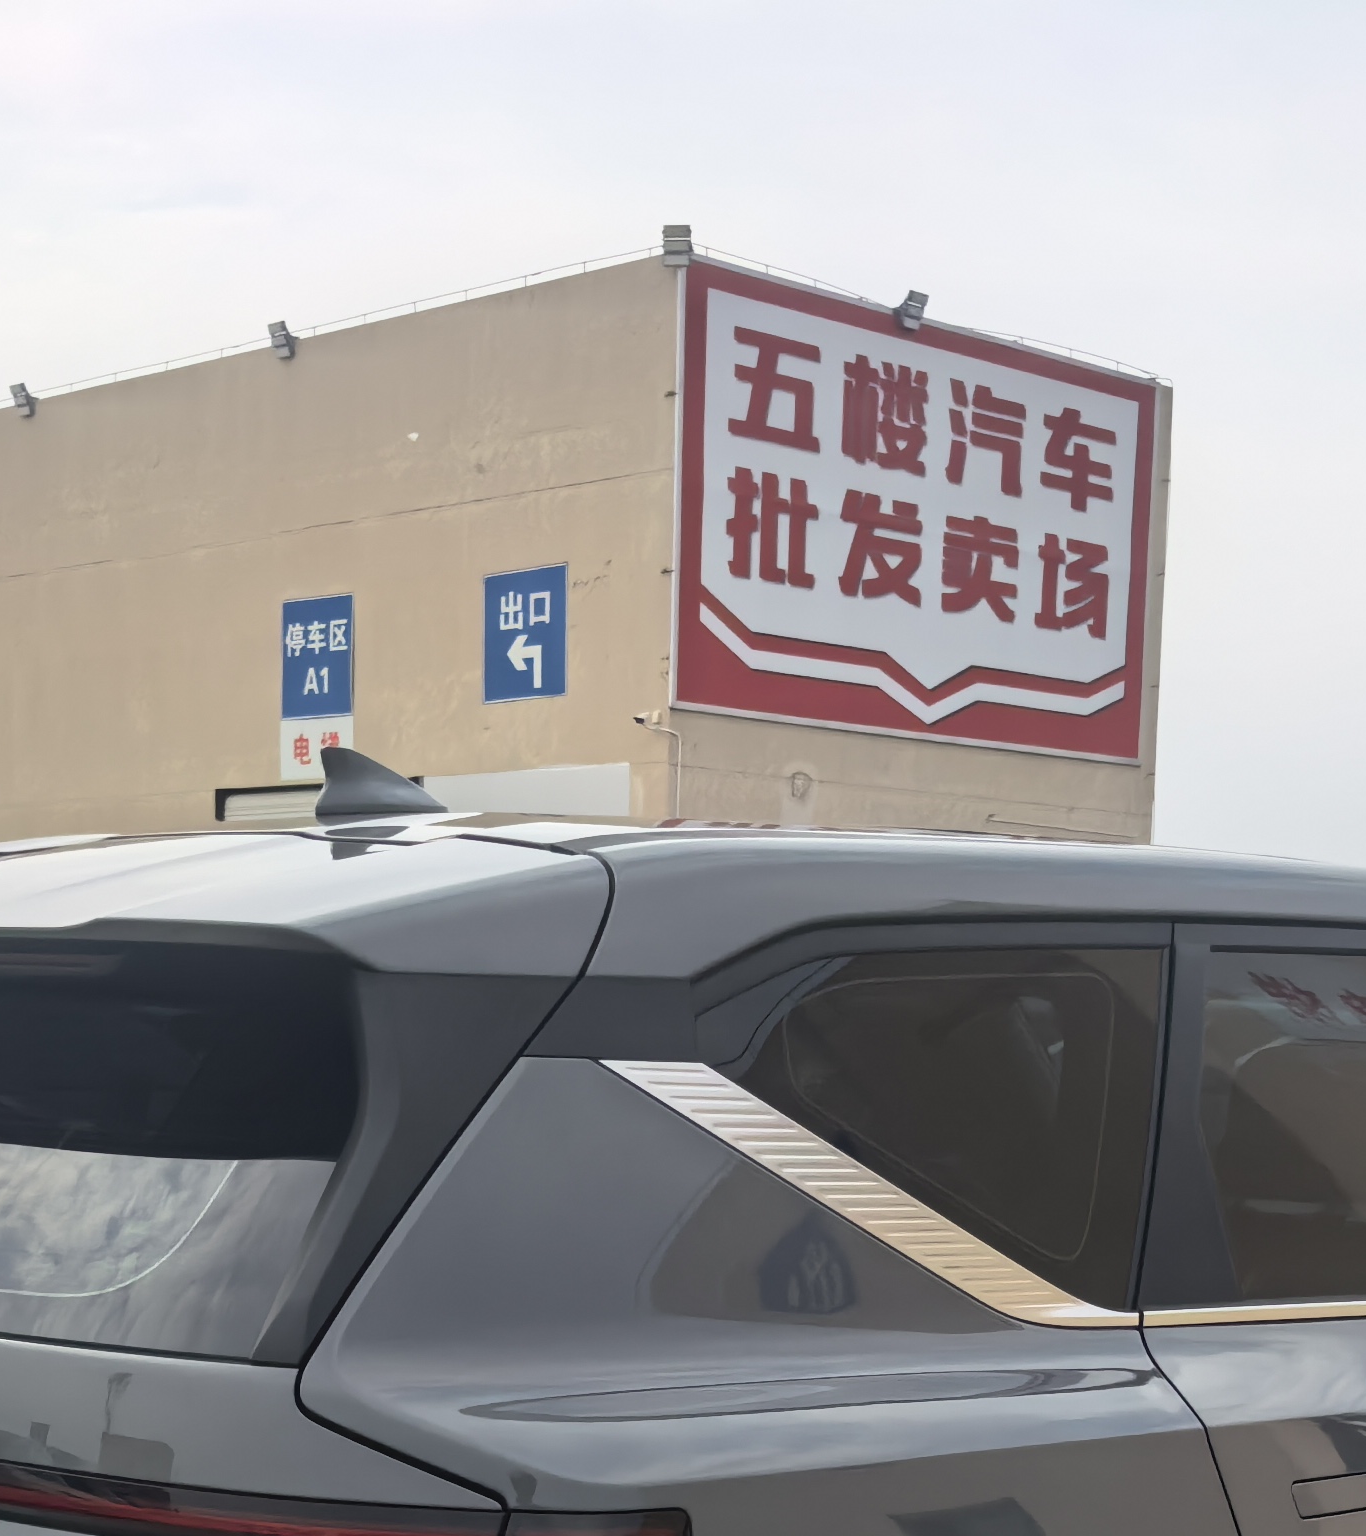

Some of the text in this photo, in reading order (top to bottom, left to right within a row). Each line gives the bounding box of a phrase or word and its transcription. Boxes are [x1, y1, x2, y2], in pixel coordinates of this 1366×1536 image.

[727, 325, 1118, 513] 五楼汽车
[725, 465, 1110, 641] 批发卖场
[498, 591, 551, 631] 出口
[284, 618, 349, 658] 停车区
[302, 666, 331, 696] A1
